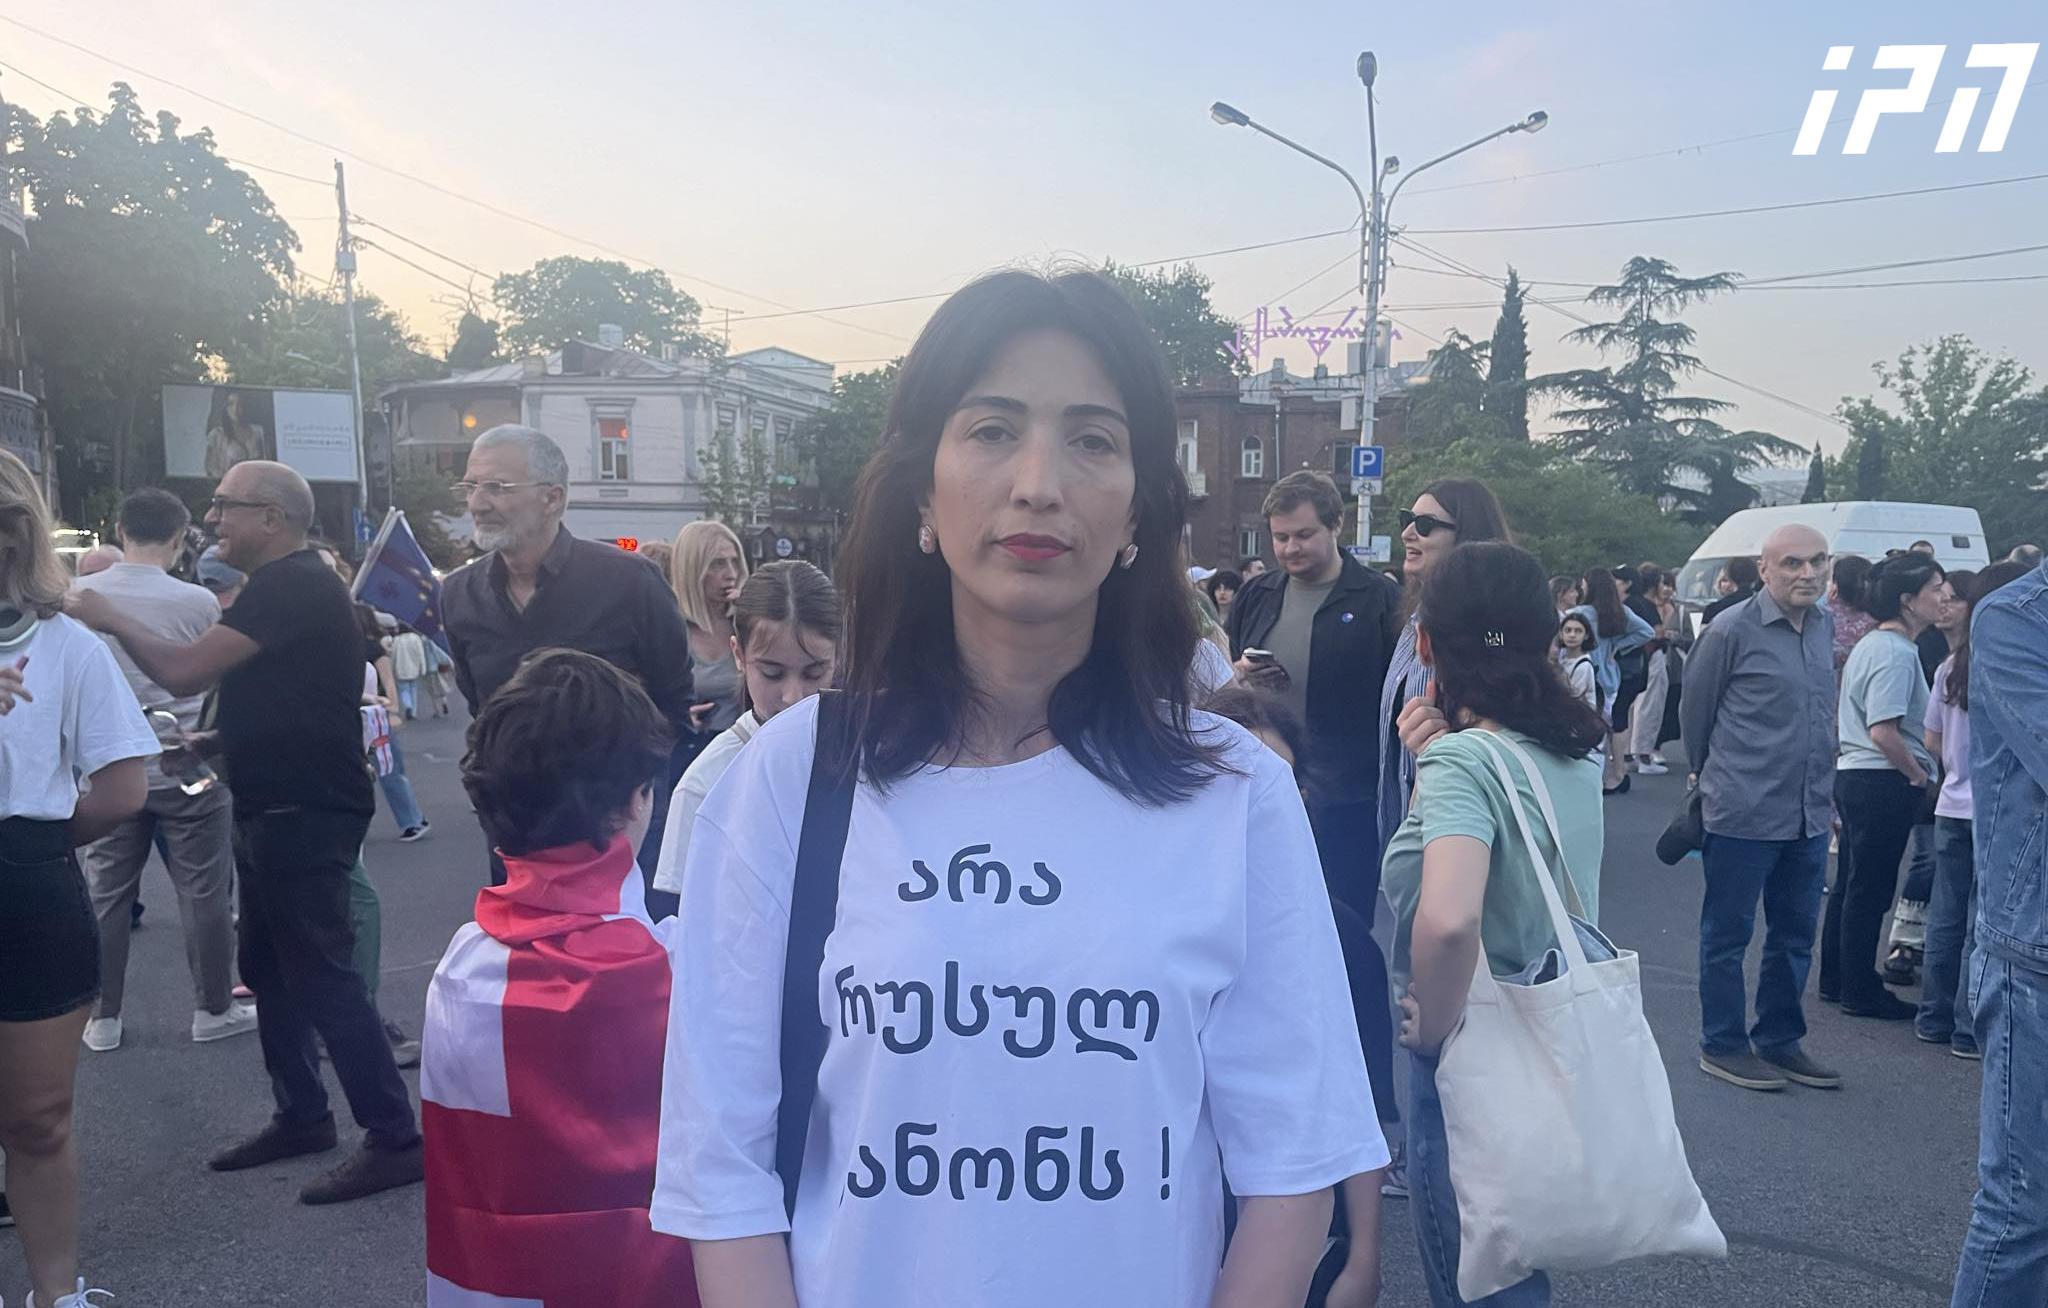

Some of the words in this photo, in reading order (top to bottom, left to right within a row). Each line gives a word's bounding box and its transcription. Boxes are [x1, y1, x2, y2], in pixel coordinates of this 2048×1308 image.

[1359, 450, 1376, 475] P
[898, 844, 1062, 906] არა
[835, 961, 1160, 1061] რუსულ
[848, 1122, 1124, 1201] ანონს
[1160, 1126, 1170, 1200] !
